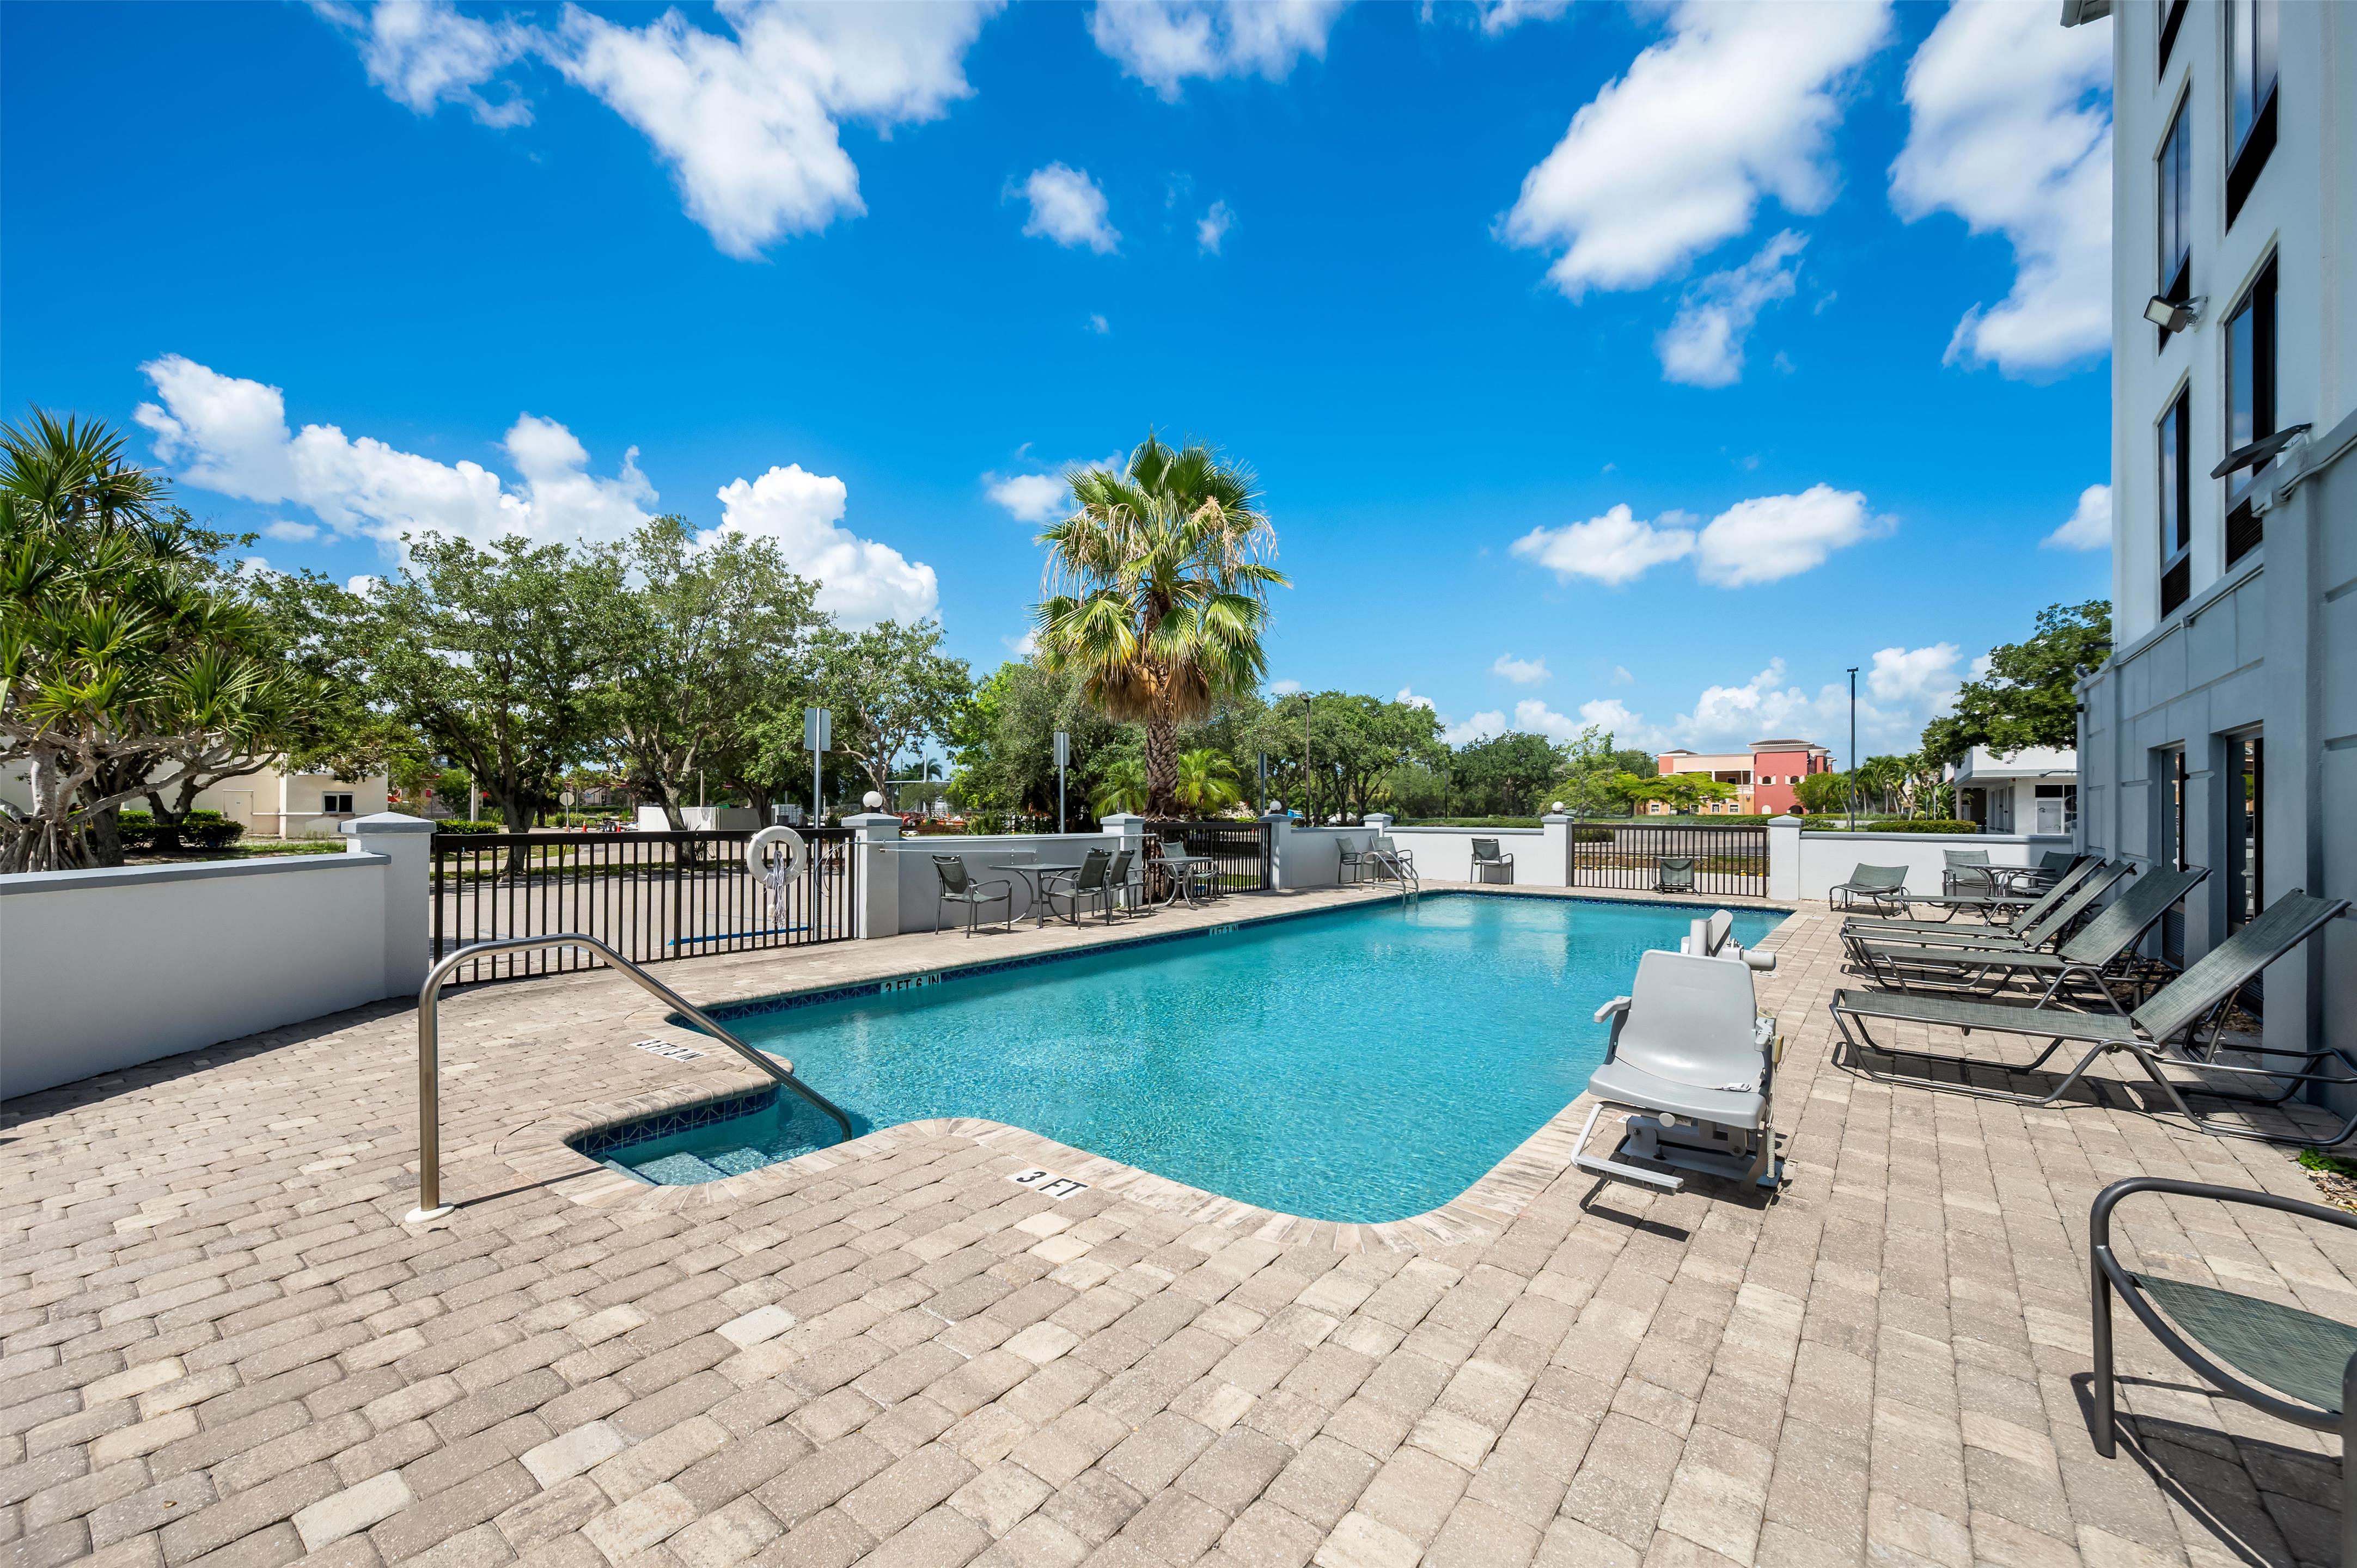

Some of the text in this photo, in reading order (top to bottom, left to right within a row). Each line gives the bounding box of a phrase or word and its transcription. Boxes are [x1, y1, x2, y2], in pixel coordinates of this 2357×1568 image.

[897, 979, 911, 990] FT
[917, 977, 922, 987] 6
[929, 974, 939, 985] IN
[645, 1043, 678, 1051] FT
[1016, 1172, 1089, 1197] 3 FT
